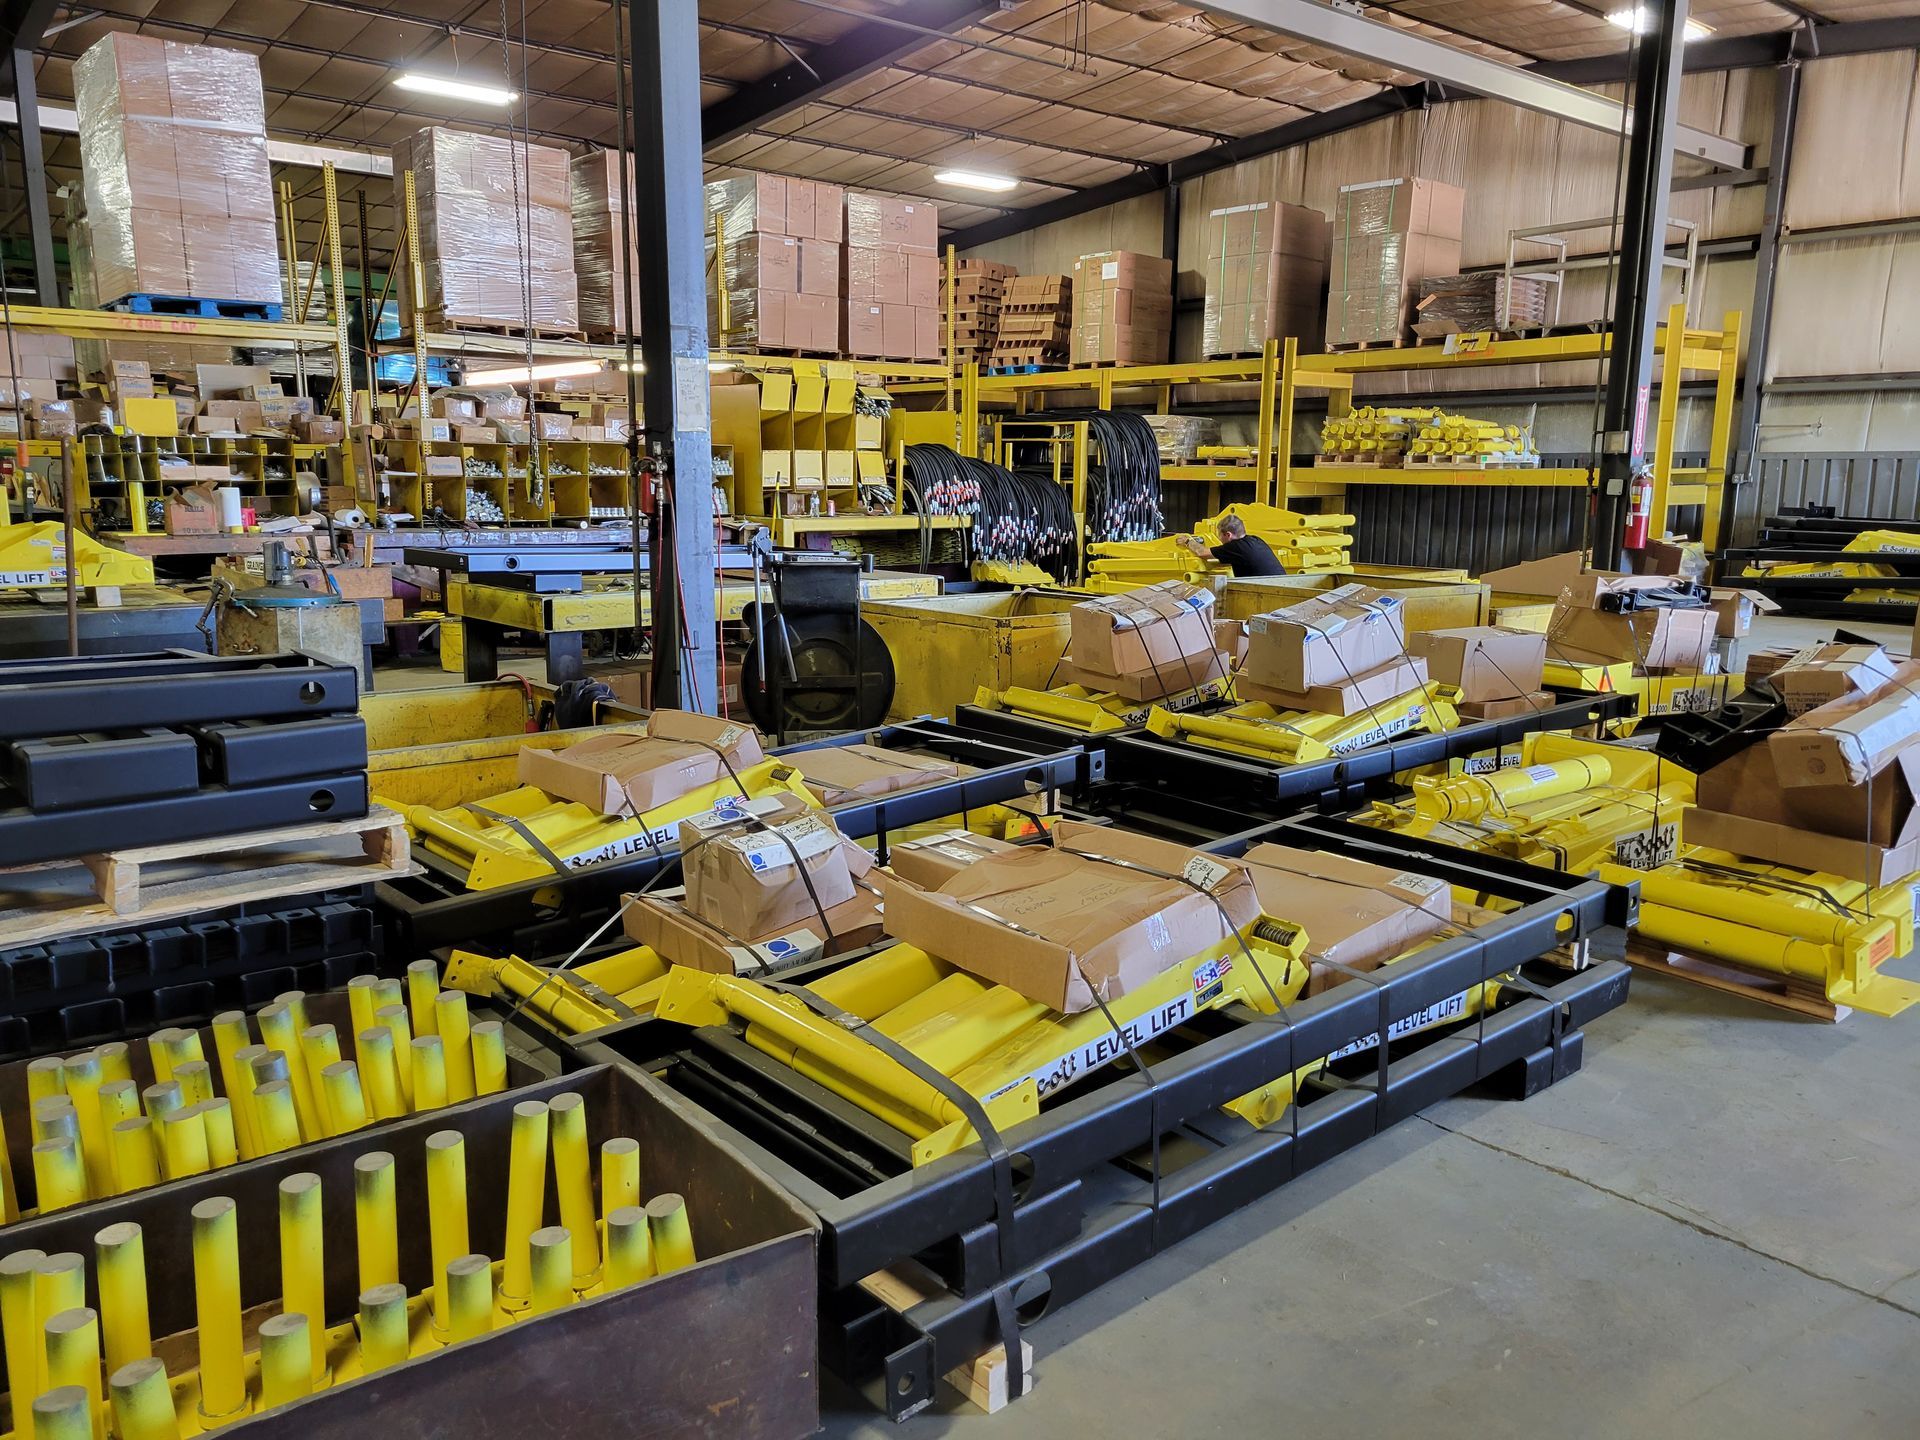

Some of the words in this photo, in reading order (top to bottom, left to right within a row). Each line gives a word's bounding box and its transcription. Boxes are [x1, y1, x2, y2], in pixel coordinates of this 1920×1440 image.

[171, 320, 197, 332] CAP
[16, 573, 45, 584] LIFT
[1160, 700, 1178, 712] EVEL
[1181, 695, 1198, 707] LIFT
[1333, 737, 1358, 755] Scott
[1360, 728, 1387, 746] LEVEL
[1389, 718, 1406, 734] LIFT
[572, 844, 619, 868] Scott
[624, 828, 674, 855] LEVEL
[1658, 850, 1673, 863] LIFT
[1195, 967, 1218, 989] USA
[1395, 1008, 1433, 1034] LEVEL
[1438, 997, 1463, 1017] LIFT
[1036, 1053, 1077, 1096] cott
[1085, 1023, 1144, 1069] LEVEL
[1151, 999, 1188, 1034] LIFT
